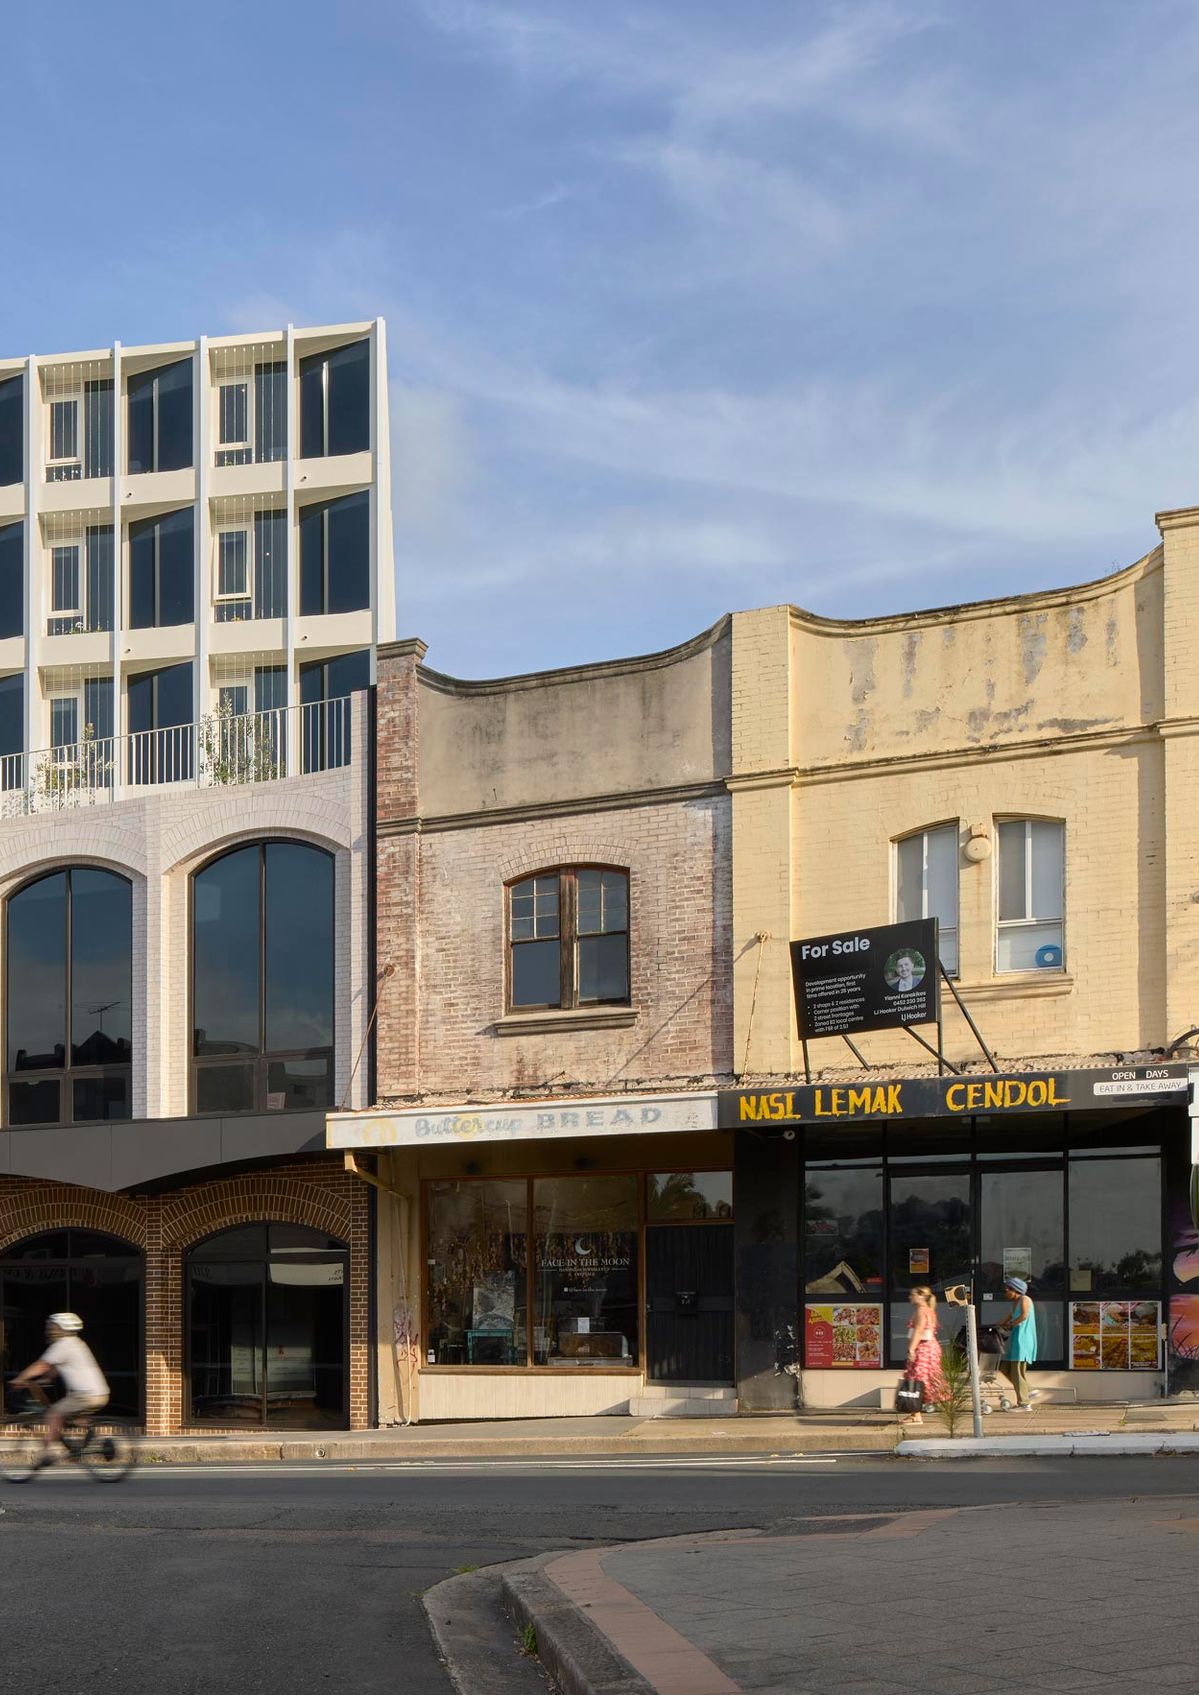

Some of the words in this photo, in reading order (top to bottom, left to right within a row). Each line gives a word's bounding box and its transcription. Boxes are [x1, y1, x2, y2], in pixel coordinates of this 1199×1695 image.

[801, 943, 829, 960] For
[832, 937, 871, 955] Sale
[805, 978, 837, 987] Development
[837, 973, 866, 982] opportunity
[907, 1012, 927, 1020] Hooker
[1112, 1071, 1136, 1080] OPEN
[1146, 1070, 1169, 1079] DAYS
[1100, 1085, 1114, 1093] EAT
[1136, 1082, 1155, 1091] TAKE
[1158, 1081, 1182, 1090] AWAY
[739, 1091, 801, 1121] NASI
[814, 1084, 903, 1117] LEMAK
[946, 1077, 1072, 1113] CENDOL
[415, 1113, 524, 1138] Buttercup
[537, 1107, 663, 1130] BREAD
[541, 1259, 565, 1267] FACE
[579, 1258, 599, 1266] THE
[600, 1258, 630, 1266] MOON
